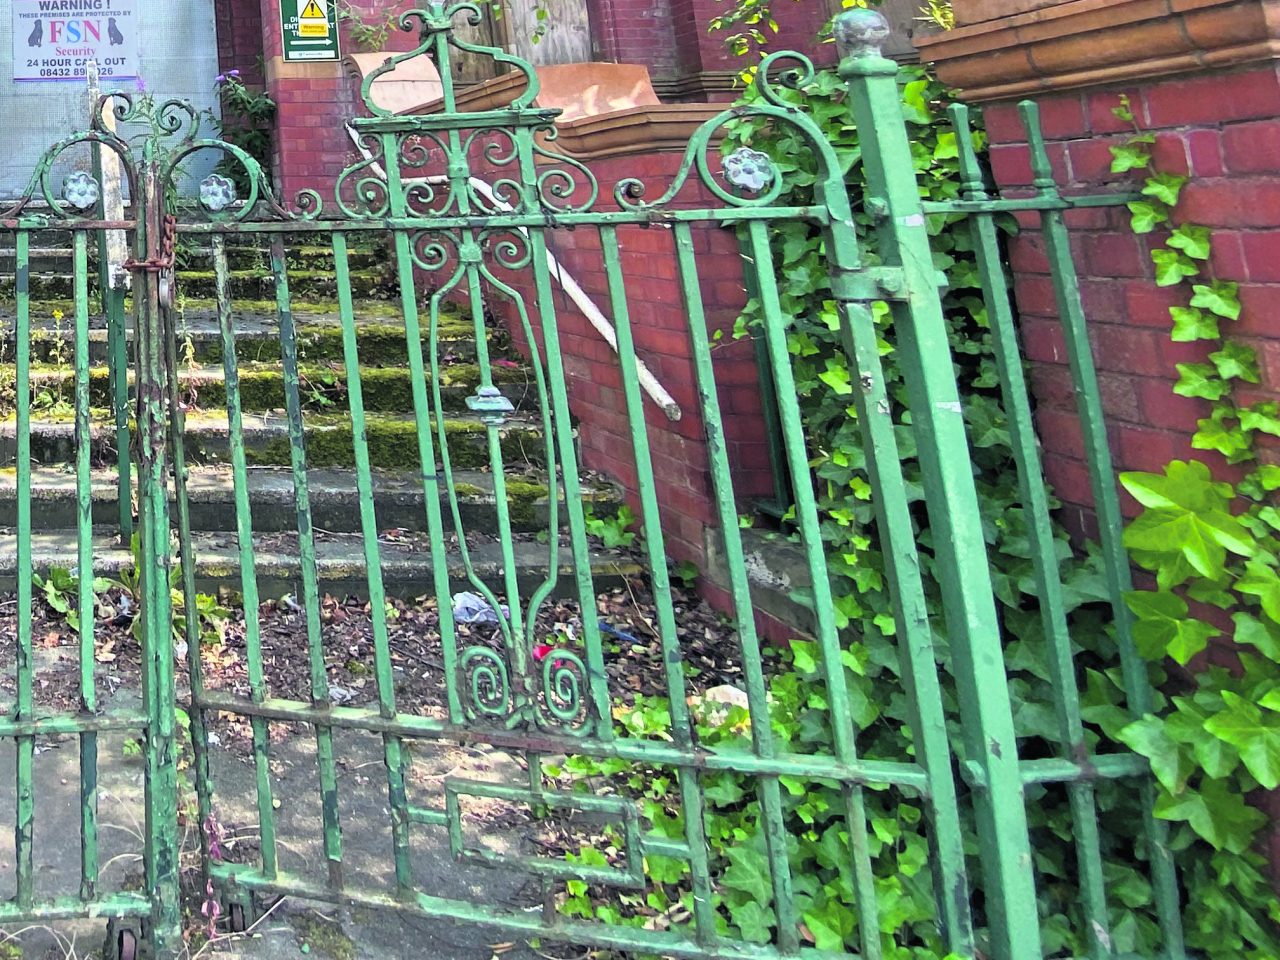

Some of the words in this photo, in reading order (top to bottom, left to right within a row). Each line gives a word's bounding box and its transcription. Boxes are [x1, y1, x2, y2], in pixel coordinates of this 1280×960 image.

[39, 0, 103, 11] WARNING
[49, 20, 101, 43] FSN
[55, 46, 96, 57] Security
[27, 59, 39, 67] 24
[42, 58, 72, 67] HOUR
[75, 57, 101, 67] CAL
[104, 57, 126, 66] OUT
[40, 68, 70, 77] 08432
